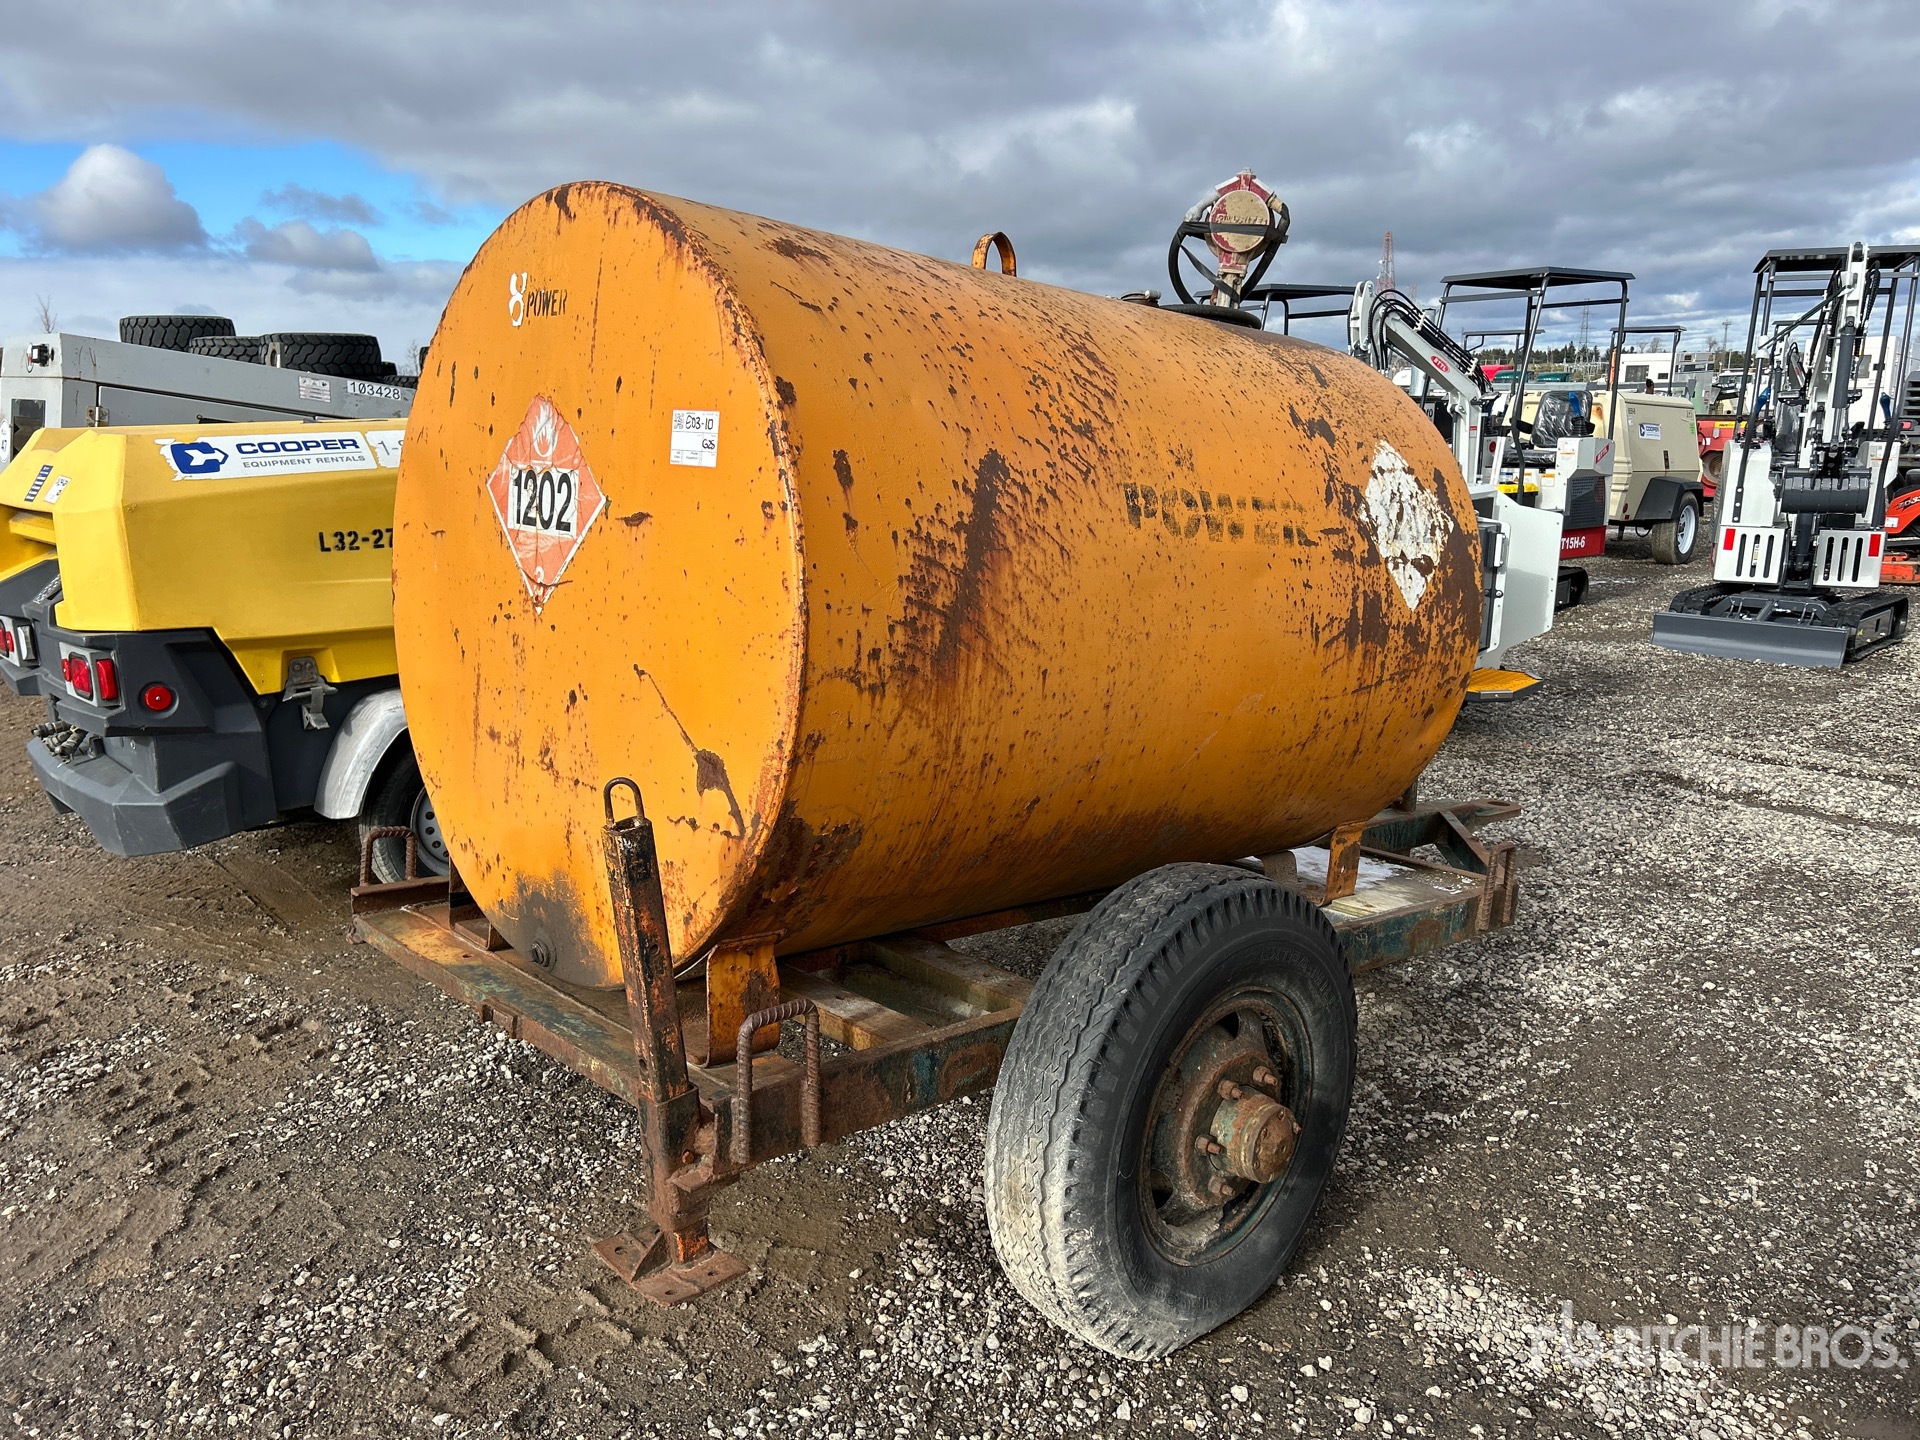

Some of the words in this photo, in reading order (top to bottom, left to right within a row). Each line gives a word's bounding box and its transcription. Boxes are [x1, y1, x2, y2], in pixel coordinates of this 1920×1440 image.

[525, 288, 568, 319] POWER
[350, 381, 401, 400] 103428
[685, 414, 714, 431] E03-10
[235, 438, 360, 455] COOPER
[242, 457, 312, 468] EQUIPMENT
[315, 454, 366, 464] RENTALS
[512, 469, 573, 532] 1202
